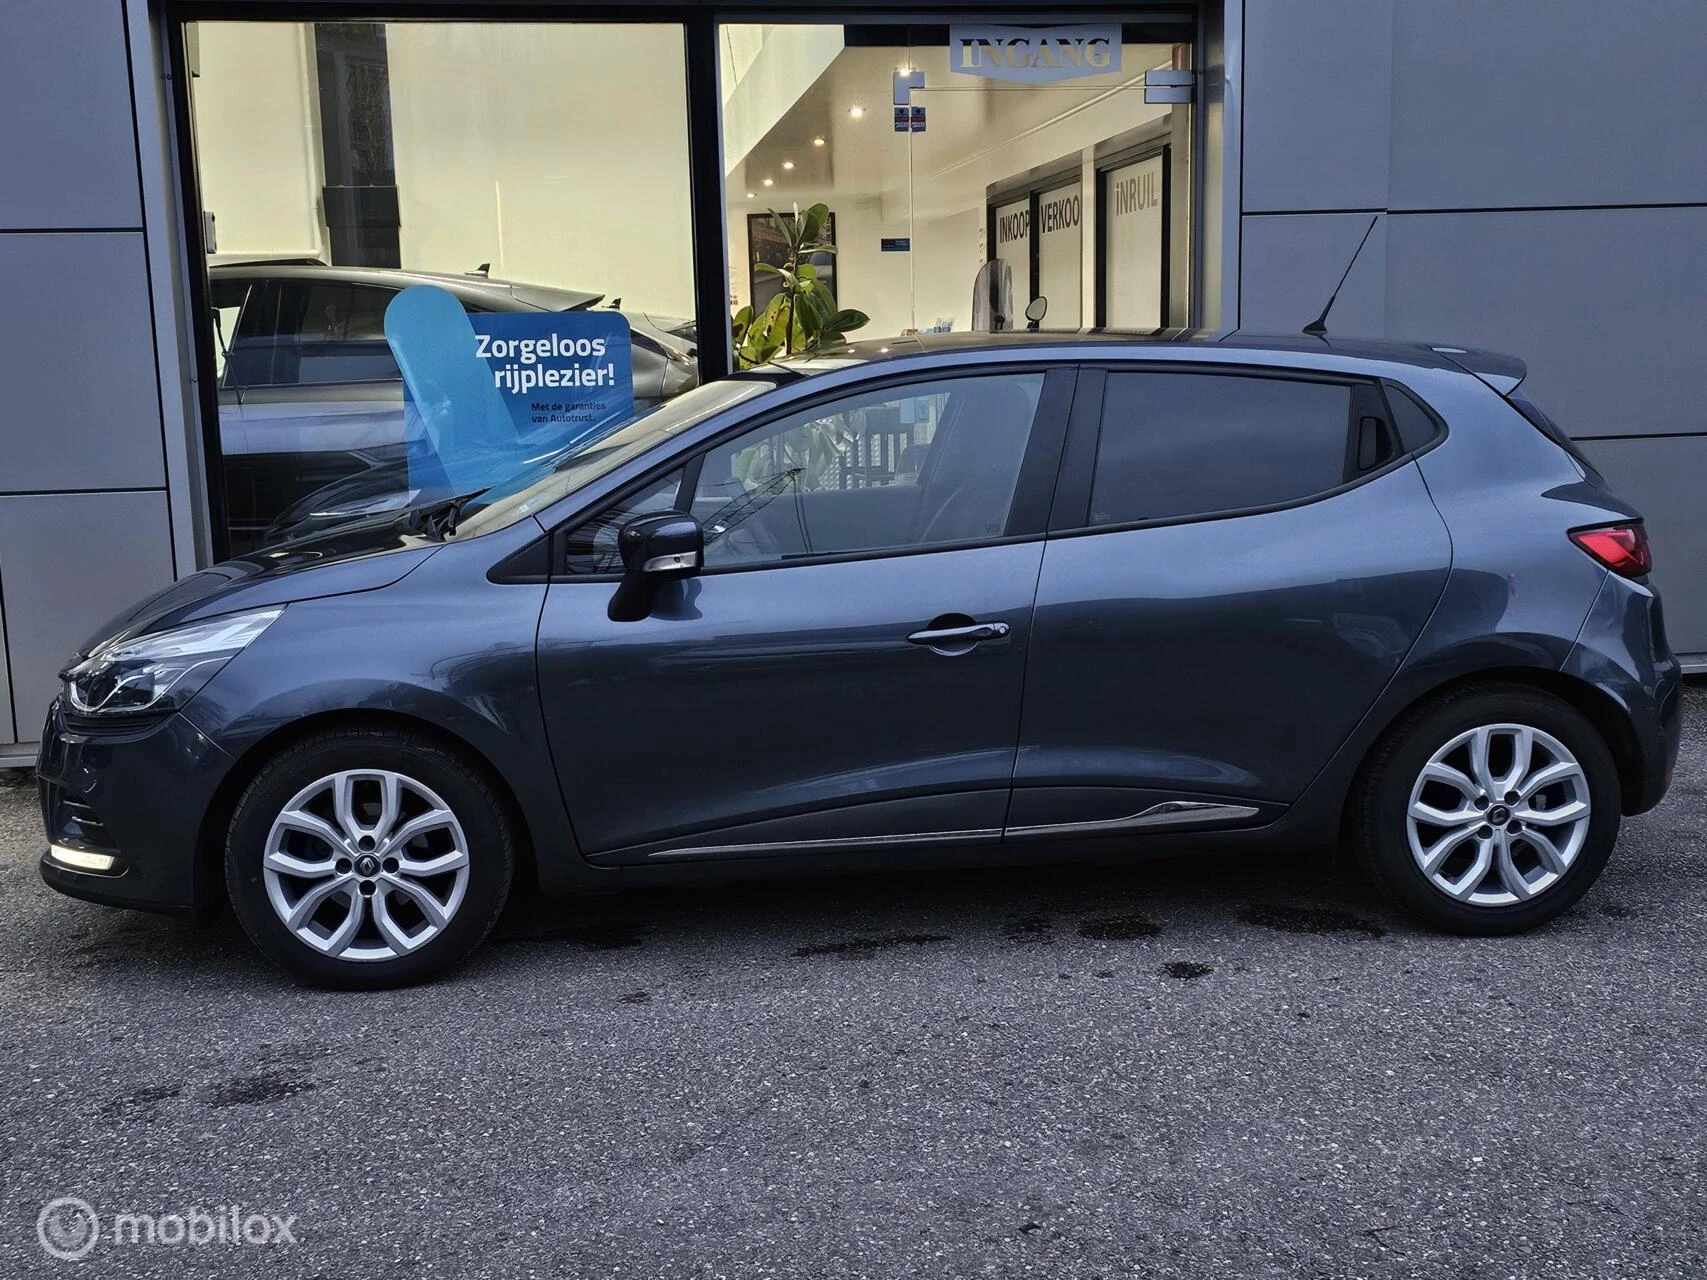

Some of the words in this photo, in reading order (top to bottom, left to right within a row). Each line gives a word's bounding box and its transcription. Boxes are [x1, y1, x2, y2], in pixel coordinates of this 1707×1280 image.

[959, 38, 1111, 68] INGANG
[475, 333, 605, 364] Zorgeloos
[495, 363, 615, 393] rijplezier!
[531, 402, 549, 411] Met
[551, 402, 563, 411] de
[565, 402, 605, 412] garanties
[531, 415, 548, 423] van
[550, 413, 596, 423] Autotrust.
